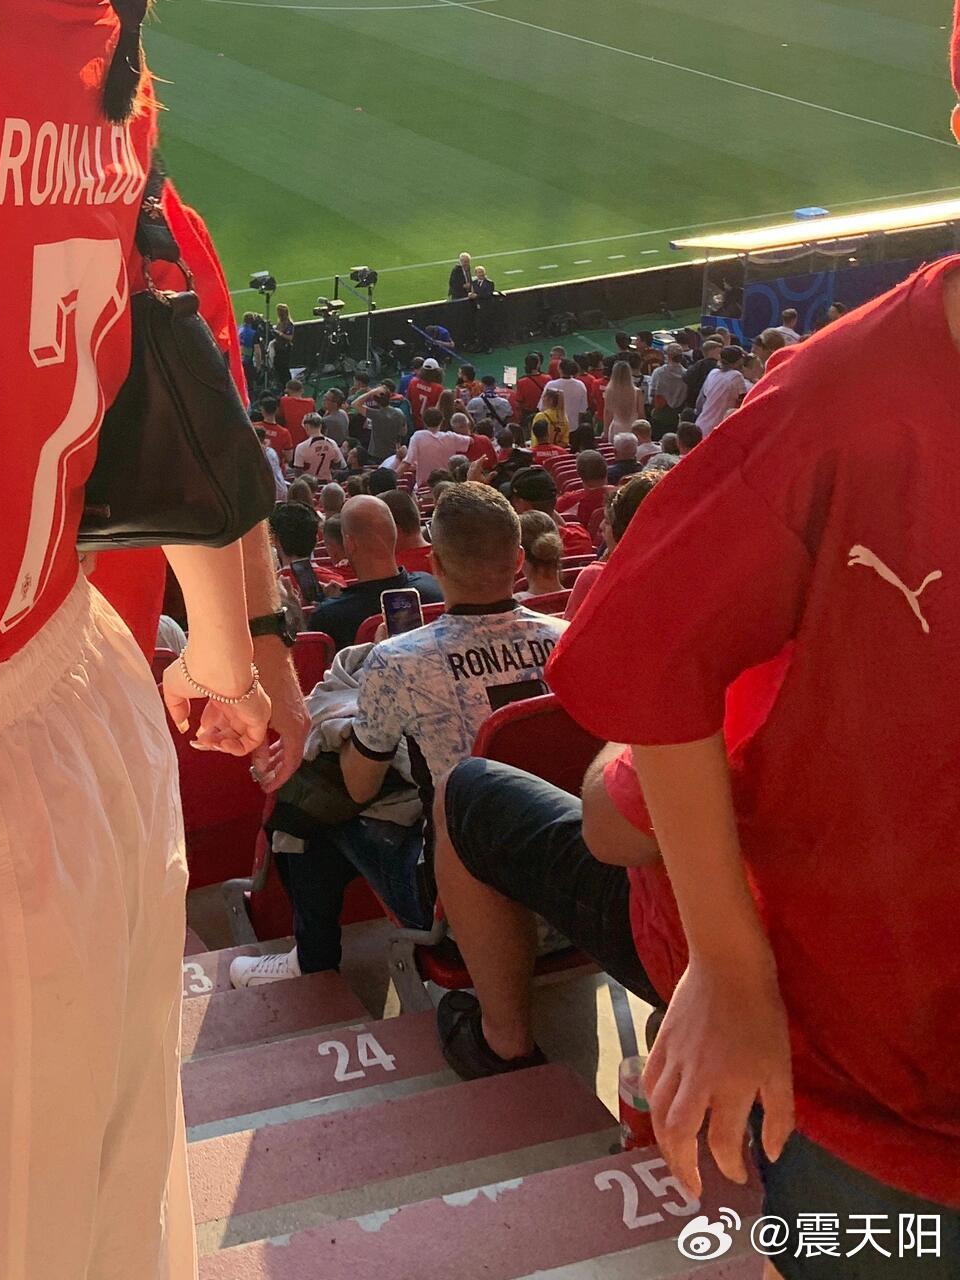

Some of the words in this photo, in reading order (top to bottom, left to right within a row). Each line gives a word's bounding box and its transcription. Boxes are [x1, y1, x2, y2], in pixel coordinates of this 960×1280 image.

[447, 638, 556, 681] RONALDO
[182, 962, 214, 996] 3
[317, 1032, 398, 1083] 24
[594, 1157, 701, 1231] 25
